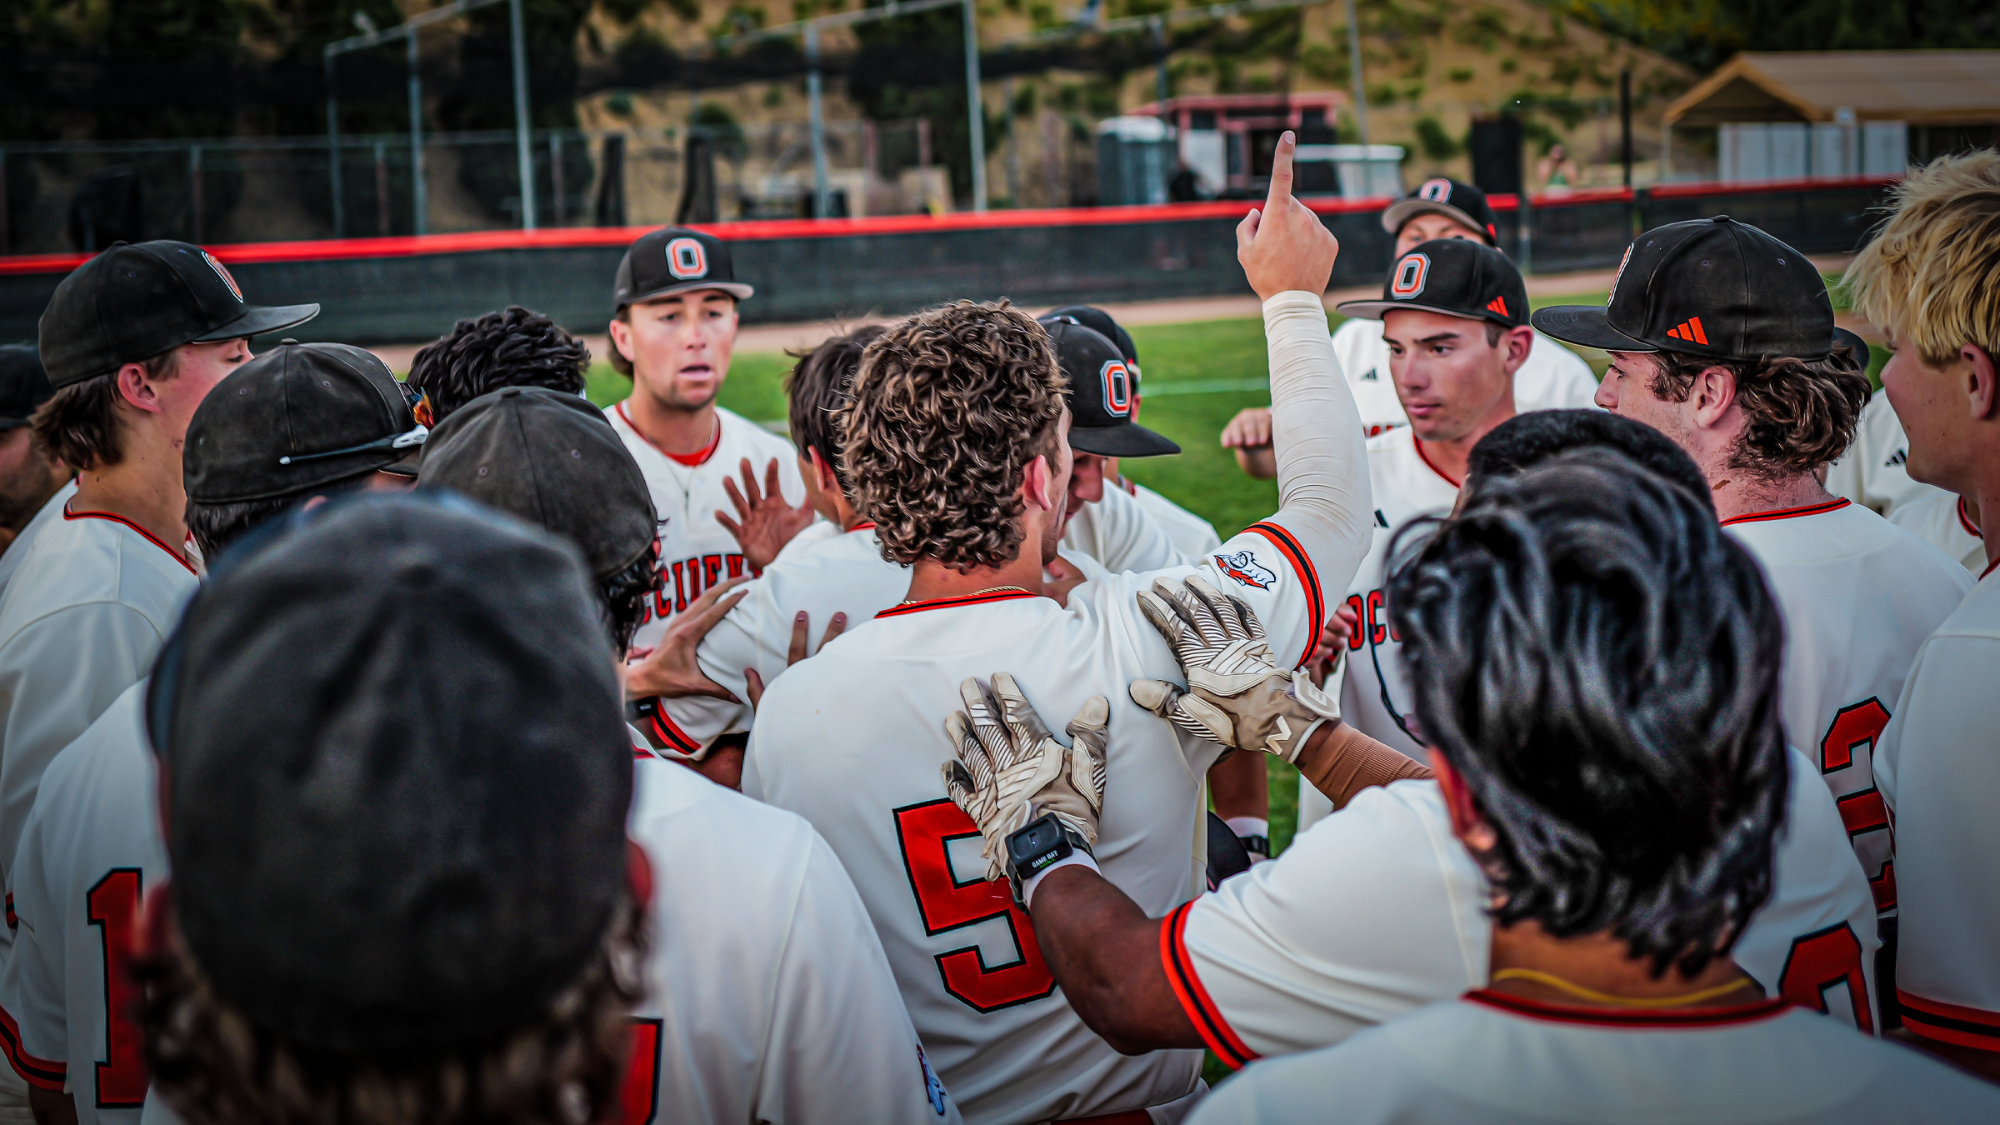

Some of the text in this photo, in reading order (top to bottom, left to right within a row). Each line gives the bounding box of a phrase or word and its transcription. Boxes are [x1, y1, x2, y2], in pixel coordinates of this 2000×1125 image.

[1420, 178, 1453, 205] O
[665, 237, 709, 281] O
[1391, 252, 1431, 300] O
[1100, 359, 1131, 418] O
[1032, 856, 1047, 868] GAME
[892, 797, 1058, 1014] 5
